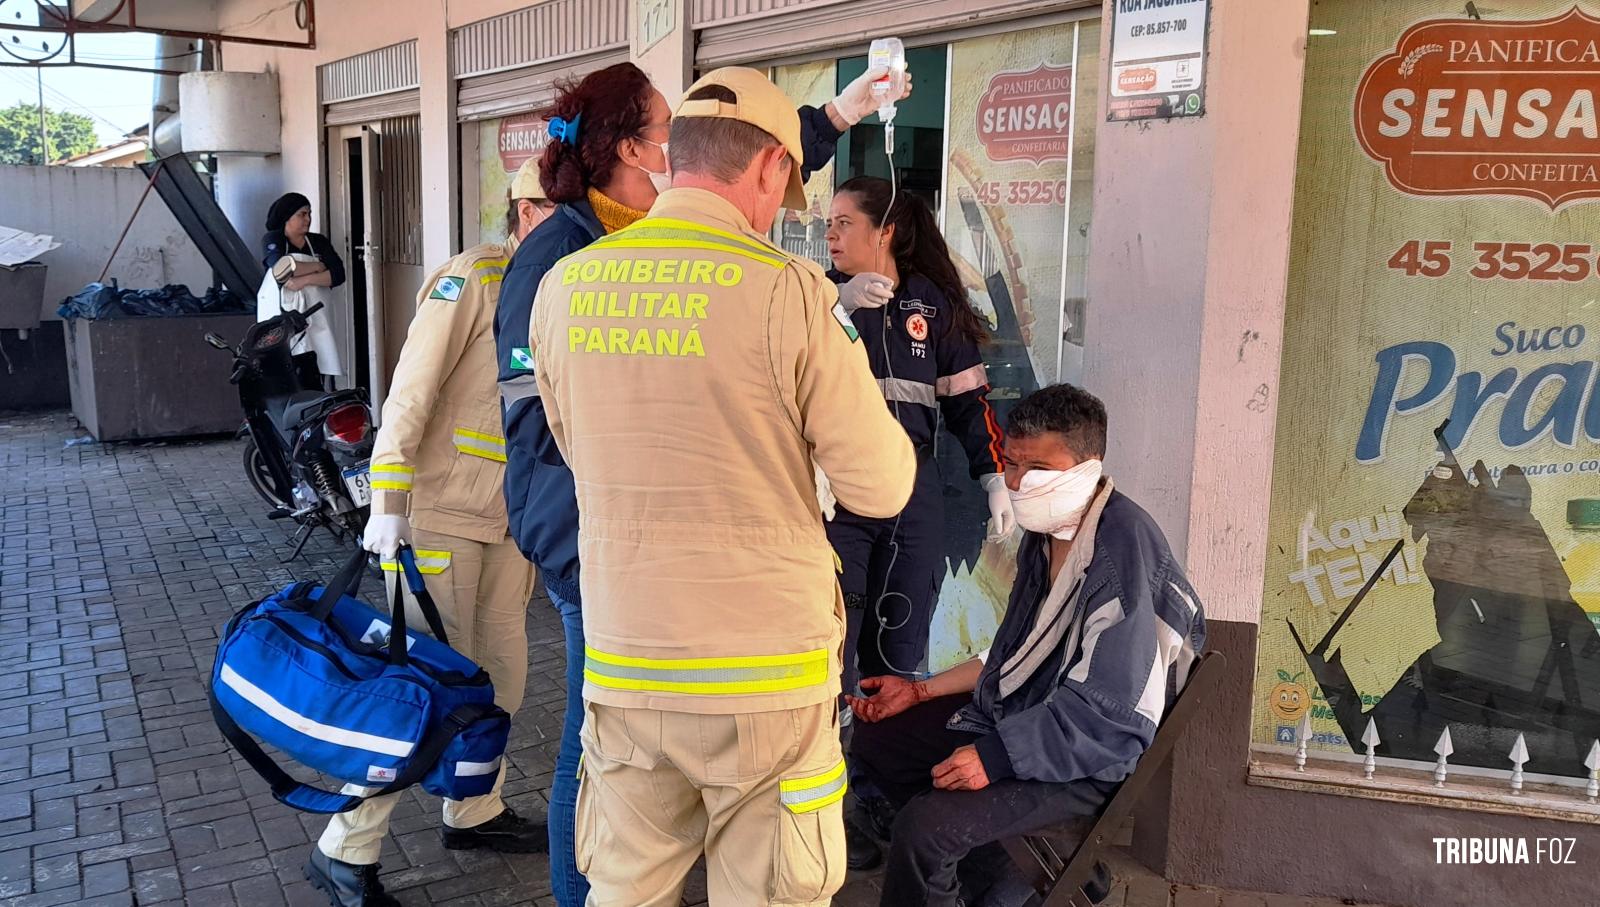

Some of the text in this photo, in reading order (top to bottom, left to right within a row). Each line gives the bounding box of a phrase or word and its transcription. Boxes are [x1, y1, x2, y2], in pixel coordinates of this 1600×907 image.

[1130, 19, 1187, 37] CEP: 85.857-700
[1447, 39, 1600, 63] PANIFICA
[1003, 76, 1071, 95] PANIFICADO
[983, 101, 1069, 133] SENSAÇ
[1378, 87, 1599, 138] SENSA
[1472, 163, 1598, 182] CONFEITA
[977, 182, 1000, 204] 45
[1387, 240, 1451, 277] 45
[562, 259, 744, 287] BOMBEIRO
[569, 291, 709, 319] MILITAR
[568, 323, 706, 357] PARANÁ
[911, 347, 926, 358] 192
[1491, 322, 1586, 356] Suco
[1563, 462, 1574, 473] o
[1579, 460, 1600, 472] co
[1297, 504, 1401, 560] Aqui
[1287, 546, 1420, 606] TEM!
